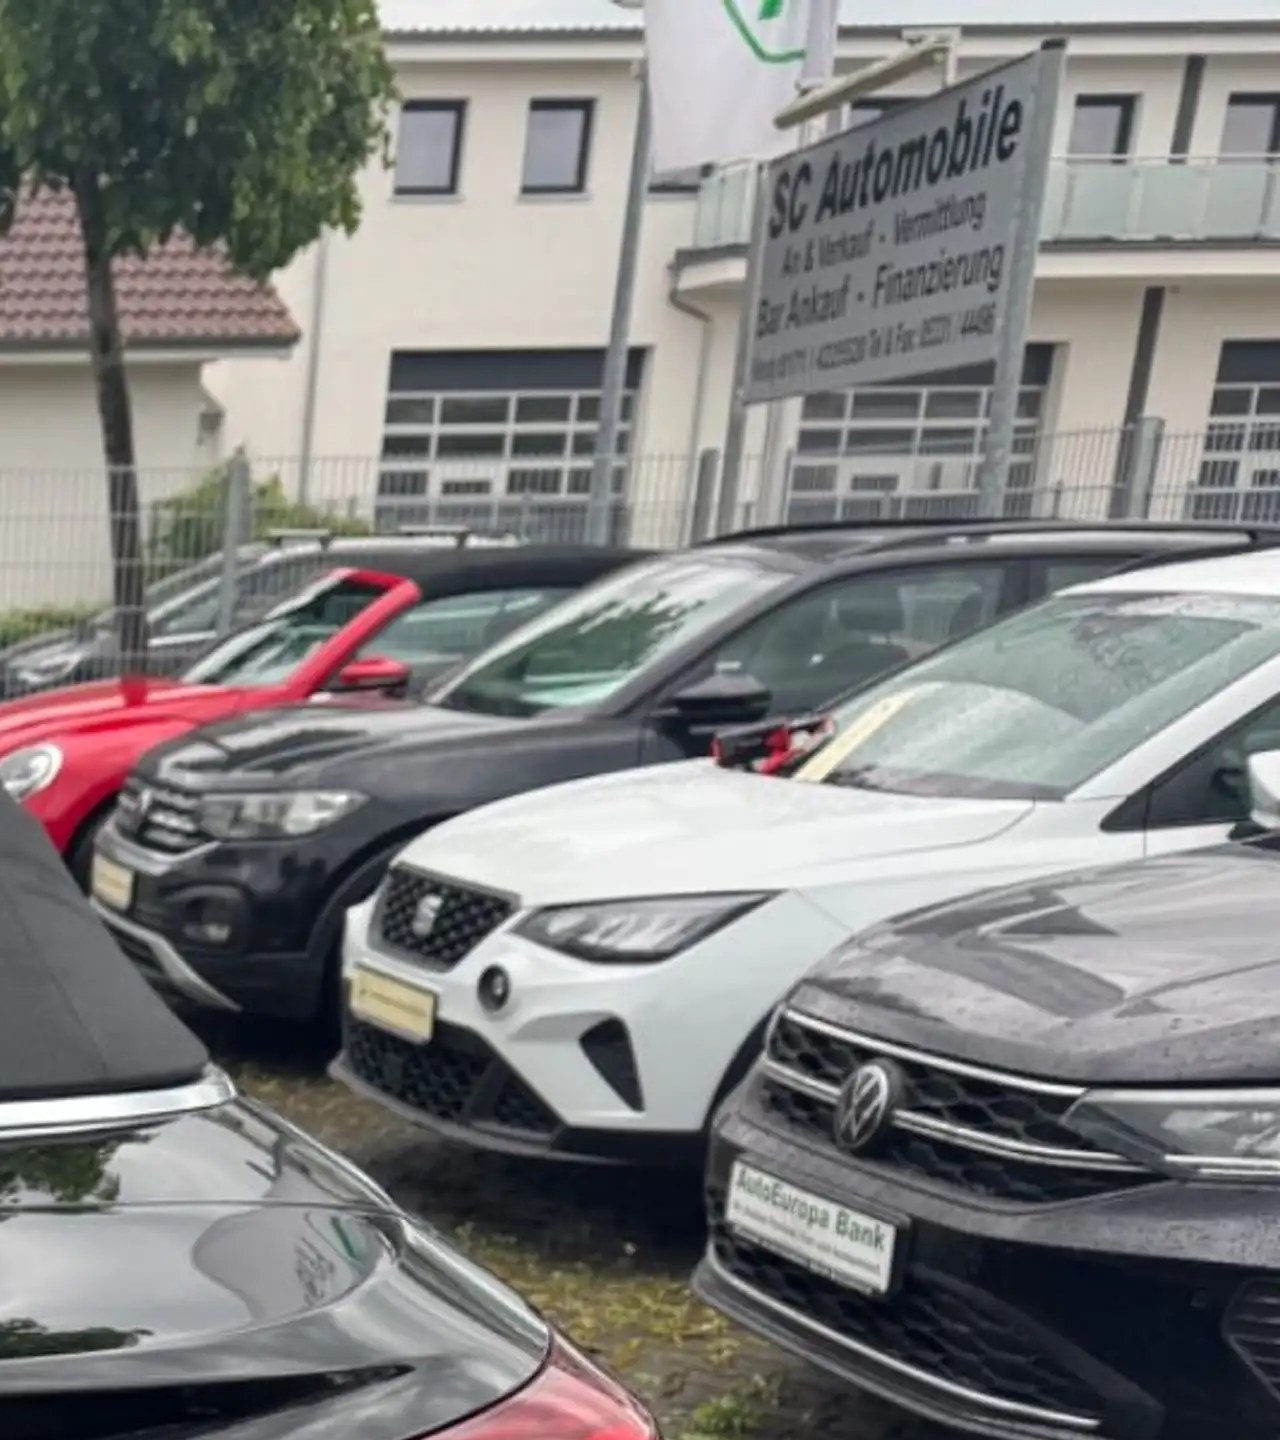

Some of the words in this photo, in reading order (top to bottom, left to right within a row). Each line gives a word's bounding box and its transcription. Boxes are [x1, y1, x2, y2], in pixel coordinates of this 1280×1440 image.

[768, 162, 812, 240] SC
[814, 84, 1024, 224] Automobile
[871, 243, 1006, 309] Finanzierung
[737, 1168, 830, 1229] AutoEuropa
[835, 1207, 886, 1253] Bank
